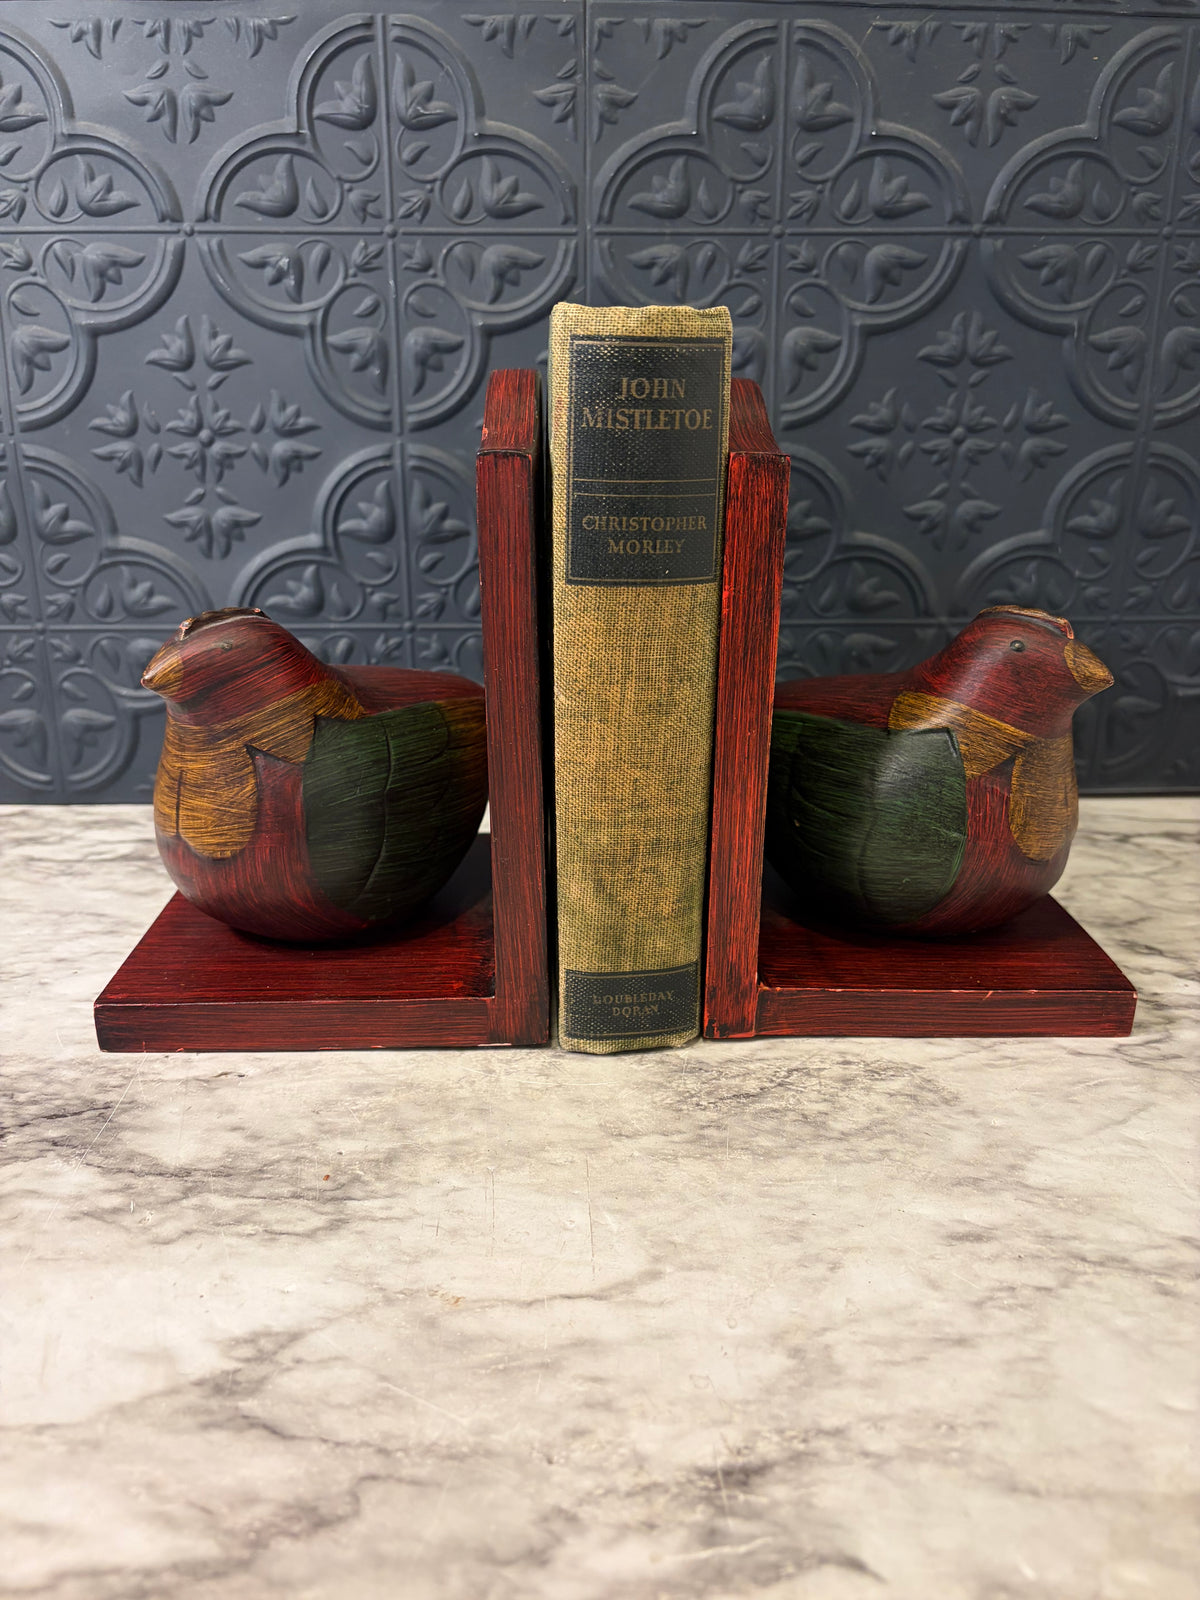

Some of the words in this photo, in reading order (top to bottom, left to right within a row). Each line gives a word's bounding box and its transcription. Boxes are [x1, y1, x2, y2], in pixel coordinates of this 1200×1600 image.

[616, 377, 686, 399] JOHN
[581, 407, 713, 430] MISTLETOE
[582, 515, 707, 531] CHRISTOPHER
[608, 539, 685, 554] MORLEY
